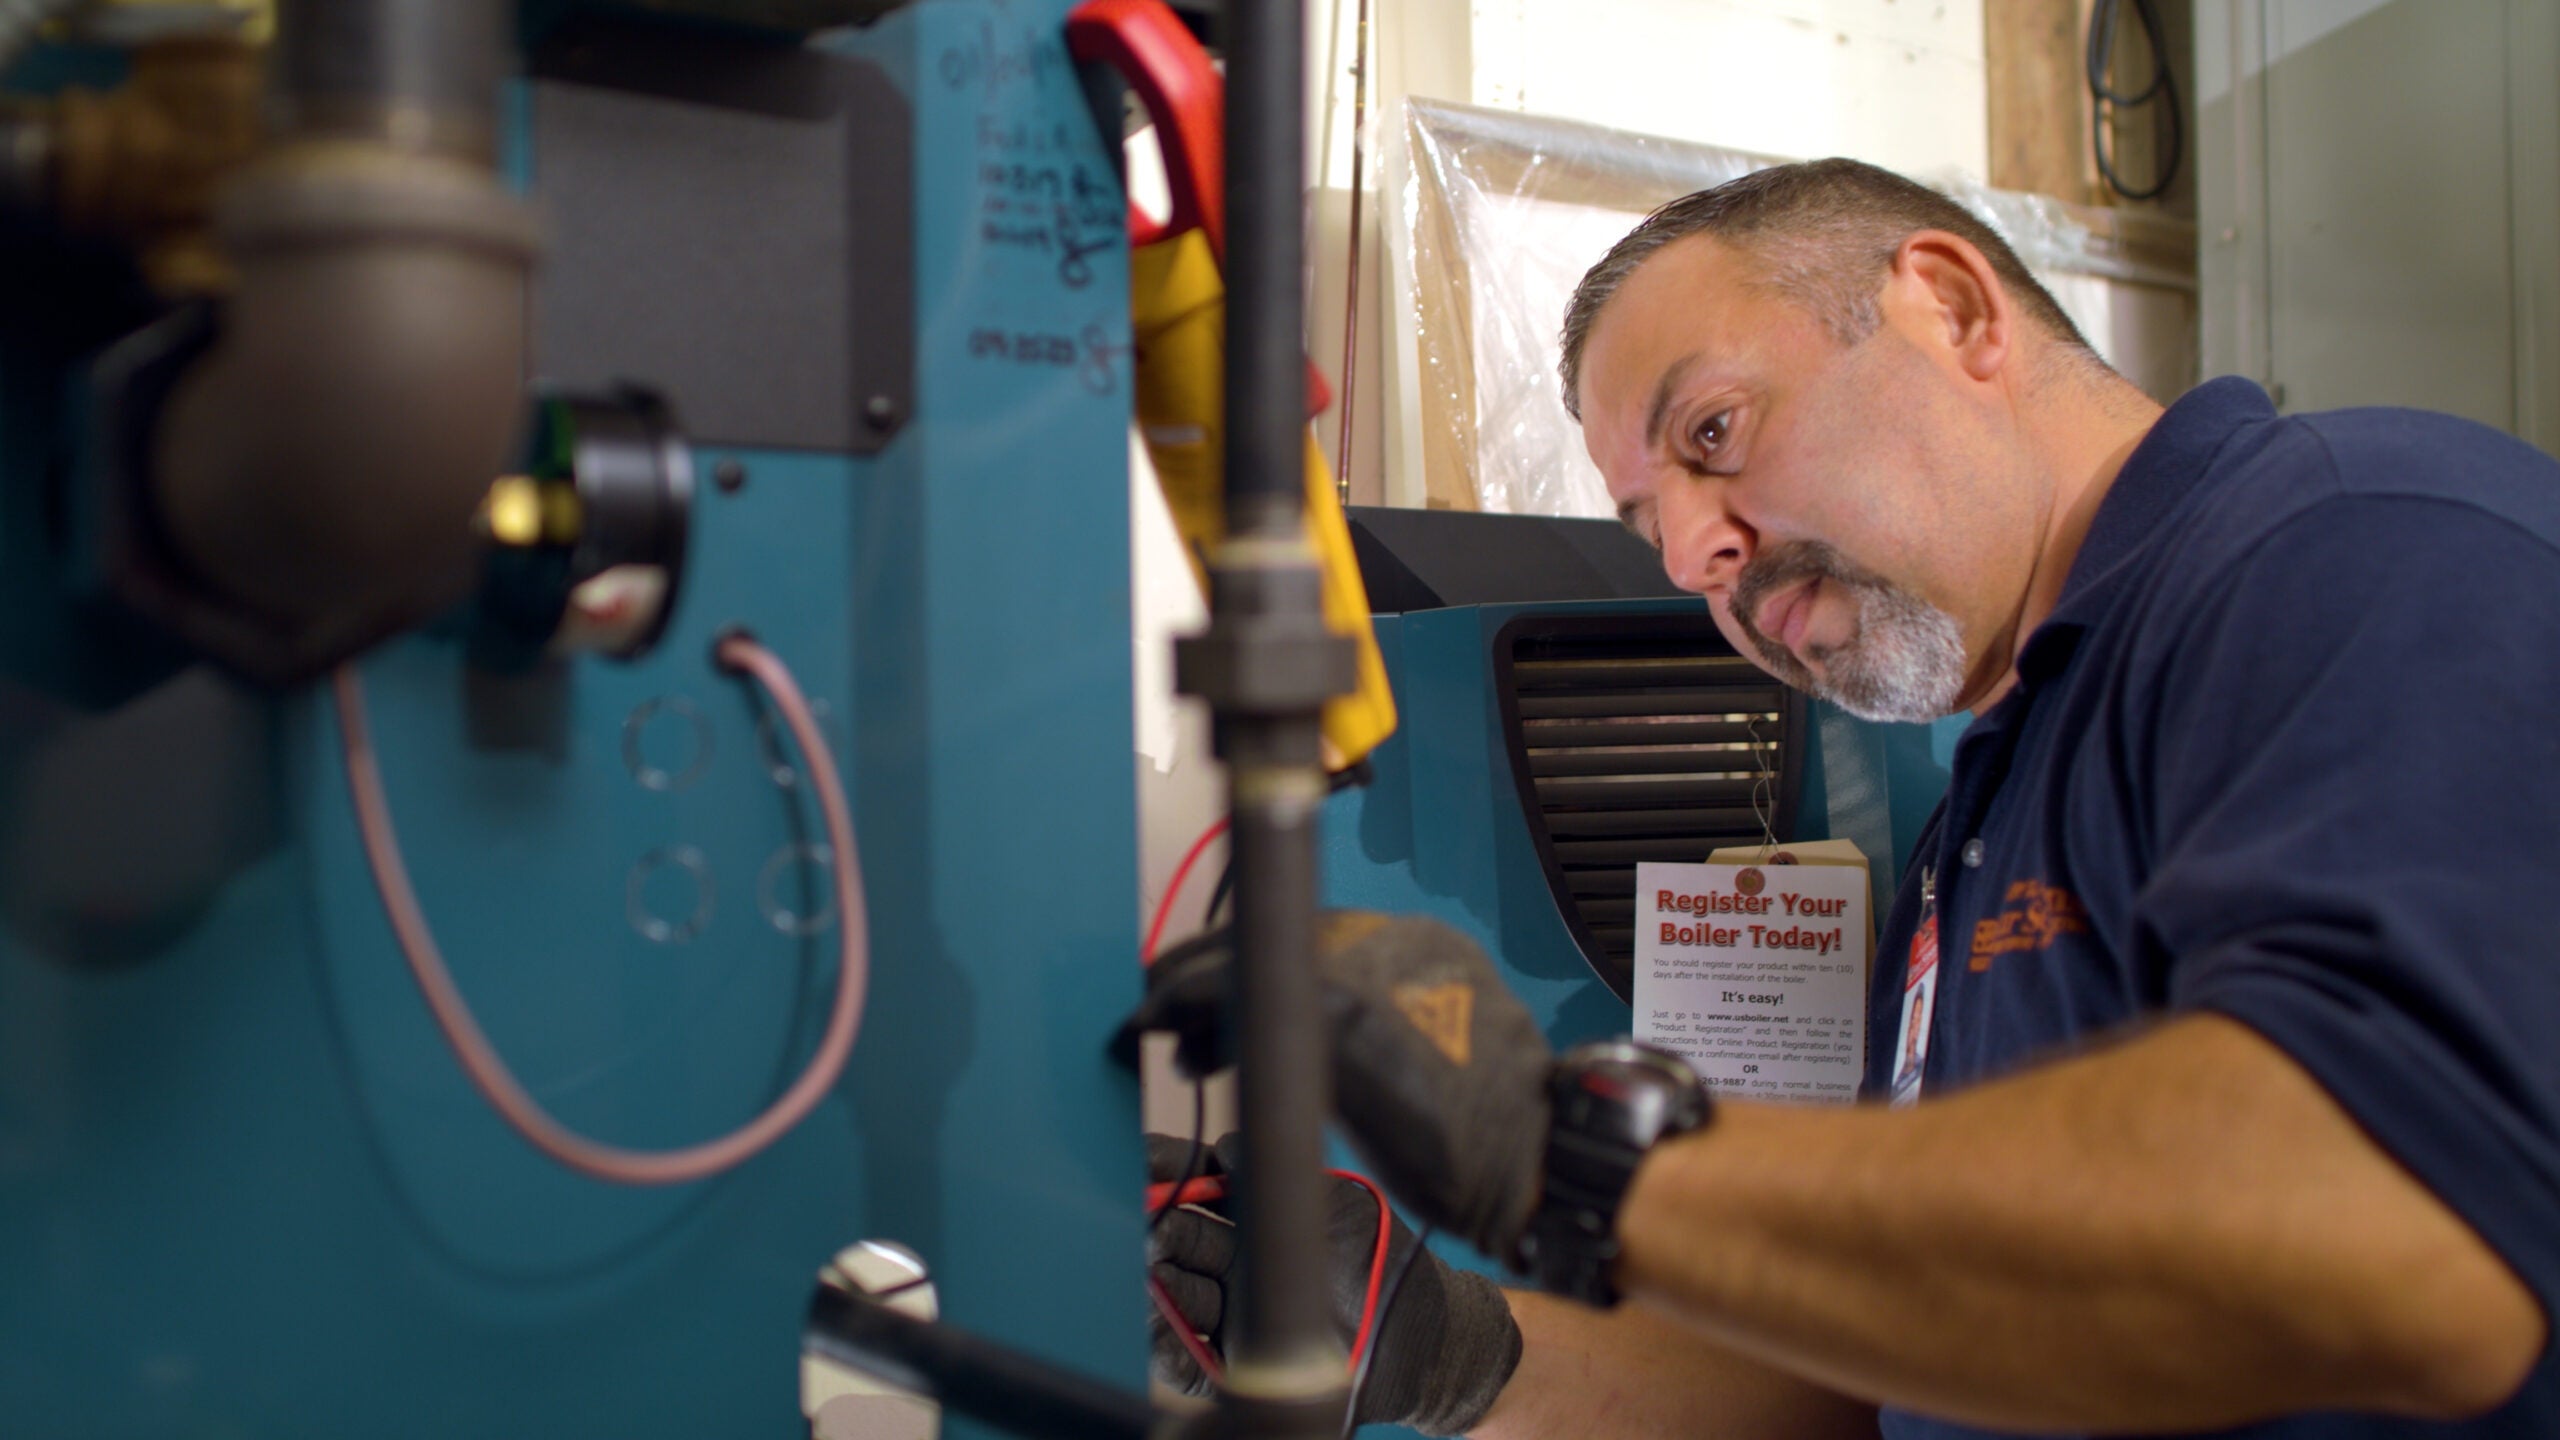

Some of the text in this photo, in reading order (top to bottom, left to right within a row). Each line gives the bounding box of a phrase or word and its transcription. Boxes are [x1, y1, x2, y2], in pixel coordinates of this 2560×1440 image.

[1657, 890, 1847, 917] Register Your
[1660, 922, 1842, 955] Boiler Today!
[1654, 958, 1668, 967] You
[1673, 958, 1699, 968] should
[1702, 961, 1732, 970] register
[1737, 962, 1754, 970] your
[1757, 961, 1788, 972] product
[1792, 962, 1816, 971] within
[1836, 963, 1854, 974] (10)
[1653, 970, 1808, 984] days after the installation of the boiler.
[1721, 991, 1784, 1006] It’s easy!
[1652, 1011, 1669, 1019] Just
[1675, 1013, 1686, 1021] go
[1692, 1012, 1701, 1020] to
[1707, 1013, 1789, 1024] www.usboiler.net
[1796, 1016, 1811, 1025] and
[1818, 1016, 1835, 1025] click
[1755, 1027, 1770, 1036] and
[1779, 1028, 1798, 1037] then
[1806, 1029, 1831, 1038] follow
[1840, 1030, 1852, 1039] the
[1652, 1036, 1853, 1053] instructions for Online Product Registration (you
[1706, 1050, 1755, 1060] confirmation
[1758, 1052, 1780, 1061] email
[1782, 1053, 1802, 1062] after
[1804, 1055, 1851, 1065] registering)
[1743, 1065, 1759, 1074] OR
[1751, 1080, 1777, 1090] during
[1783, 1081, 1811, 1090] normal
[1816, 1082, 1851, 1092] business
